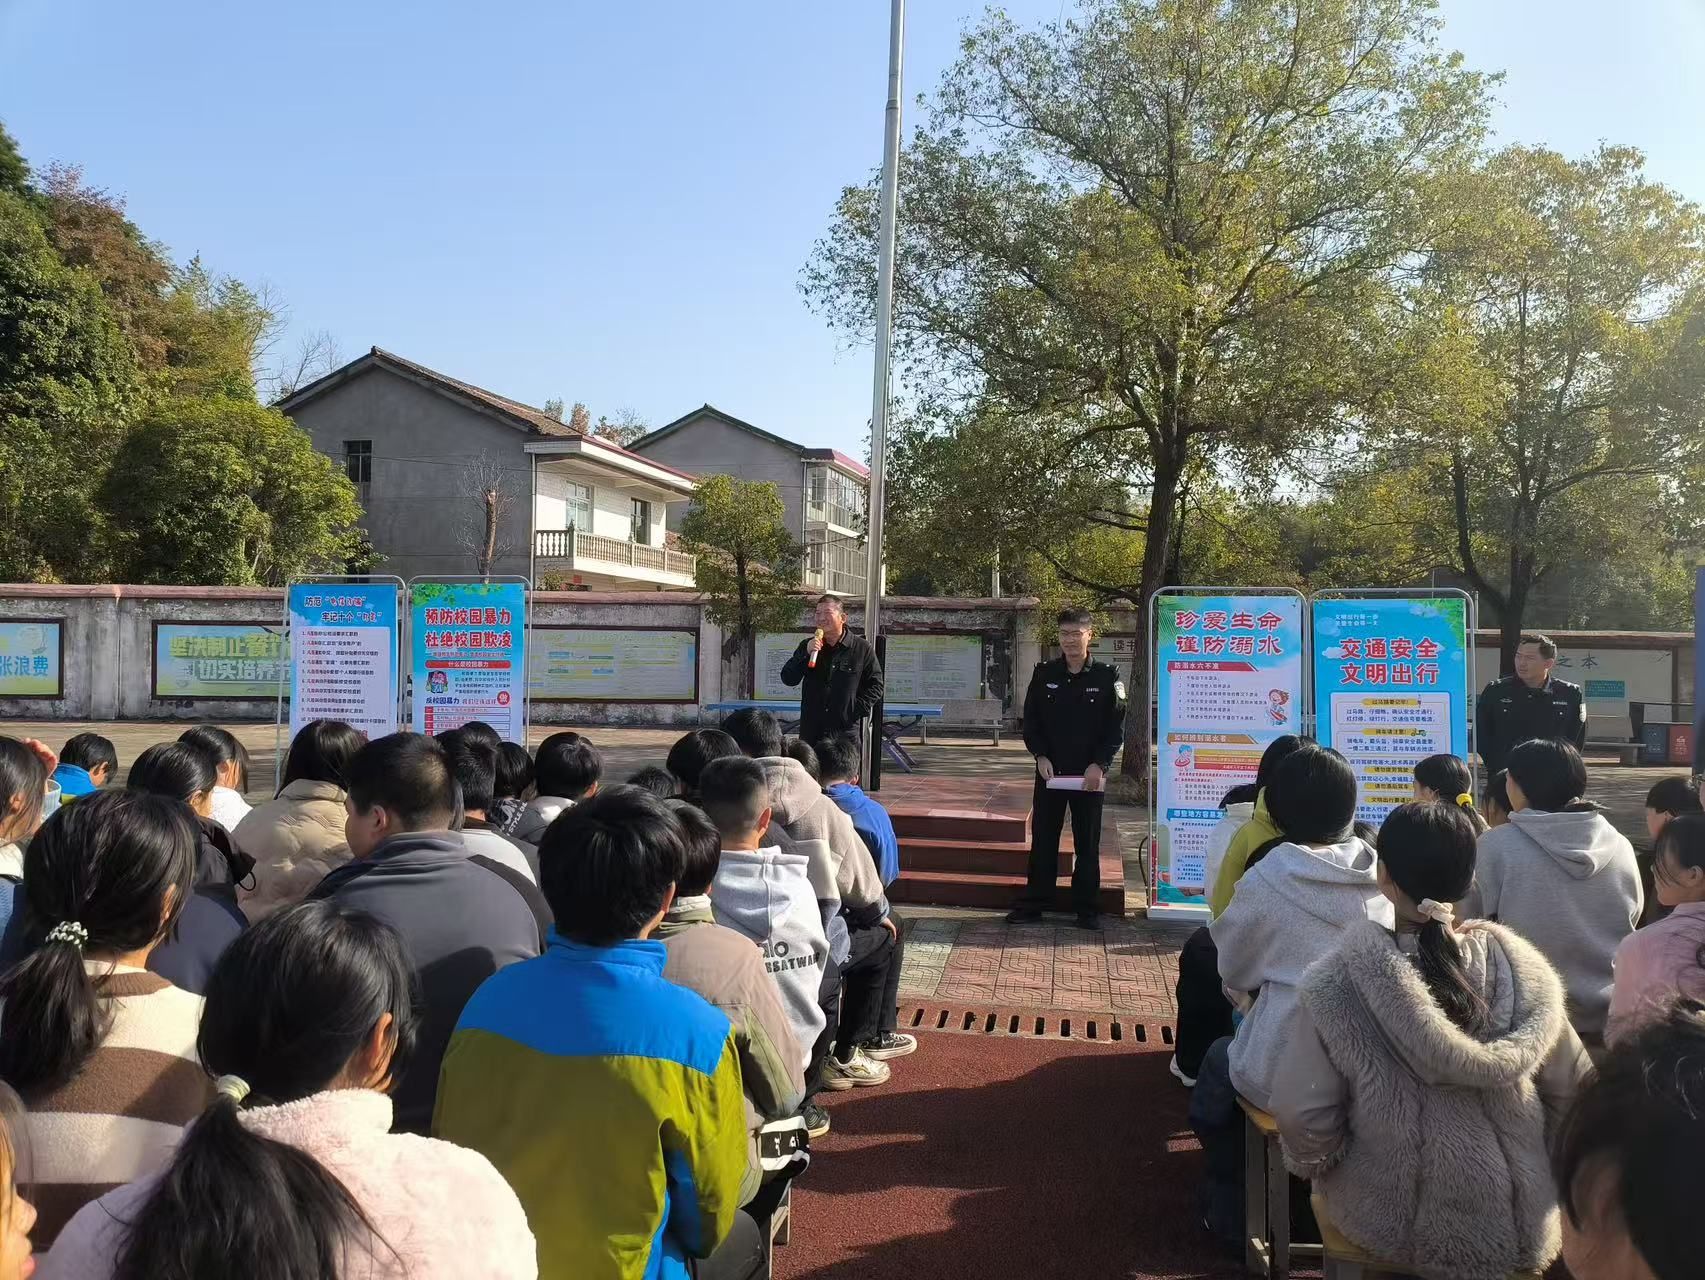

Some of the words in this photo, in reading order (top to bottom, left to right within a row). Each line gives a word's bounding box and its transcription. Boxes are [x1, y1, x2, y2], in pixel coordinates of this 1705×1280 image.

[425, 607, 512, 625] 预防校园暴力
[1175, 611, 1284, 631] 珍爱生命
[425, 631, 512, 648] 杜绝校园欺凌
[1175, 635, 1283, 655] 谨防溺水
[1340, 637, 1438, 660] 交通安全
[448, 660, 489, 668] 什么是校园暴力
[1341, 662, 1440, 684] 文明出行
